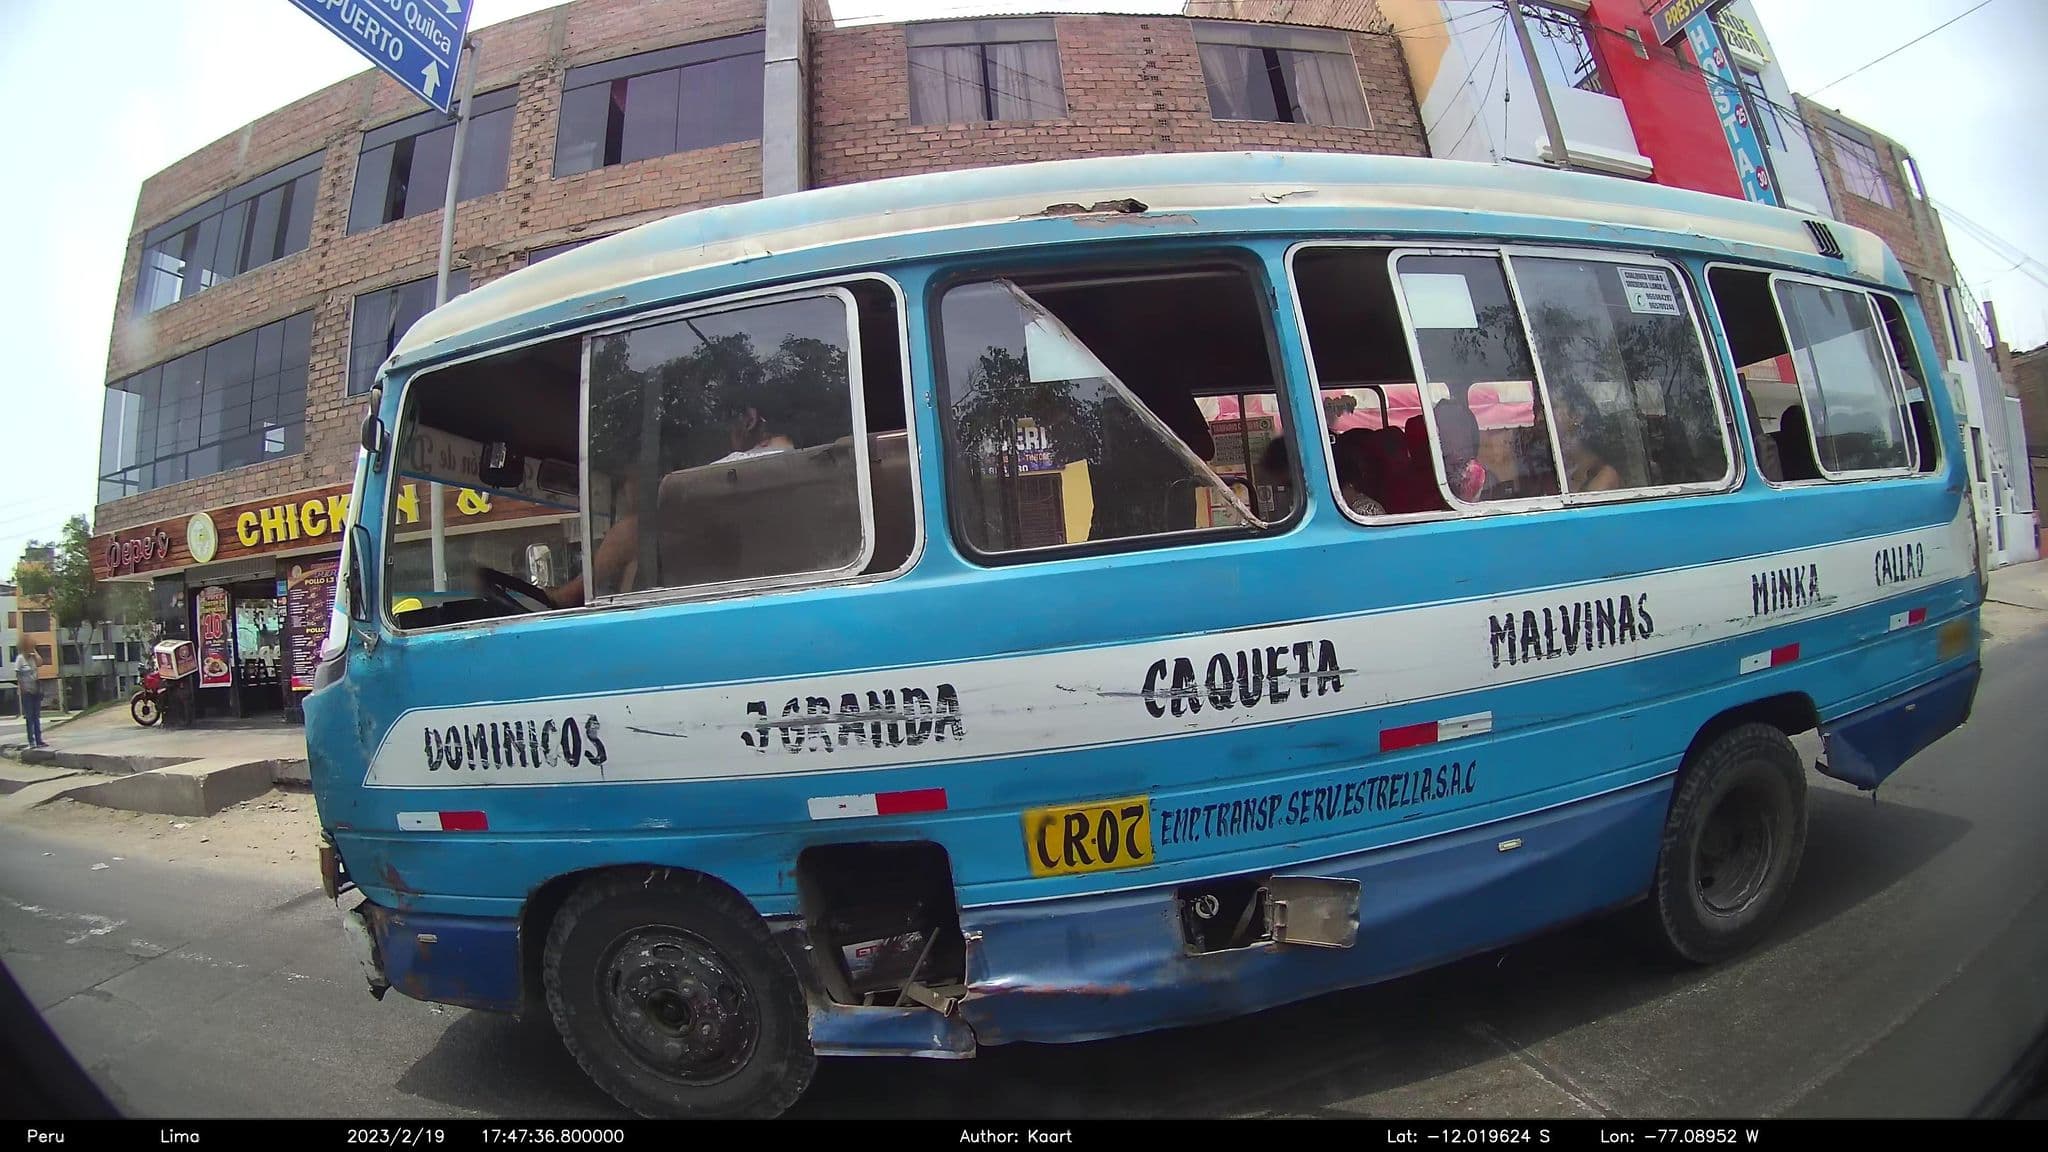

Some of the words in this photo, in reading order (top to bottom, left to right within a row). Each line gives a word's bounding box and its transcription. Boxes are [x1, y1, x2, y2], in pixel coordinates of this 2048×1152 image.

[317, 0, 403, 62] PUERTO
[404, 2, 452, 54] Quilca
[1757, 171, 1768, 188] 30
[423, 714, 606, 772] DOMINICOS
[1142, 639, 1344, 718] CAQUETA
[1489, 592, 1655, 669] MALVINAS
[1751, 563, 1822, 616] MINKA
[1875, 541, 1924, 587] CALLAO
